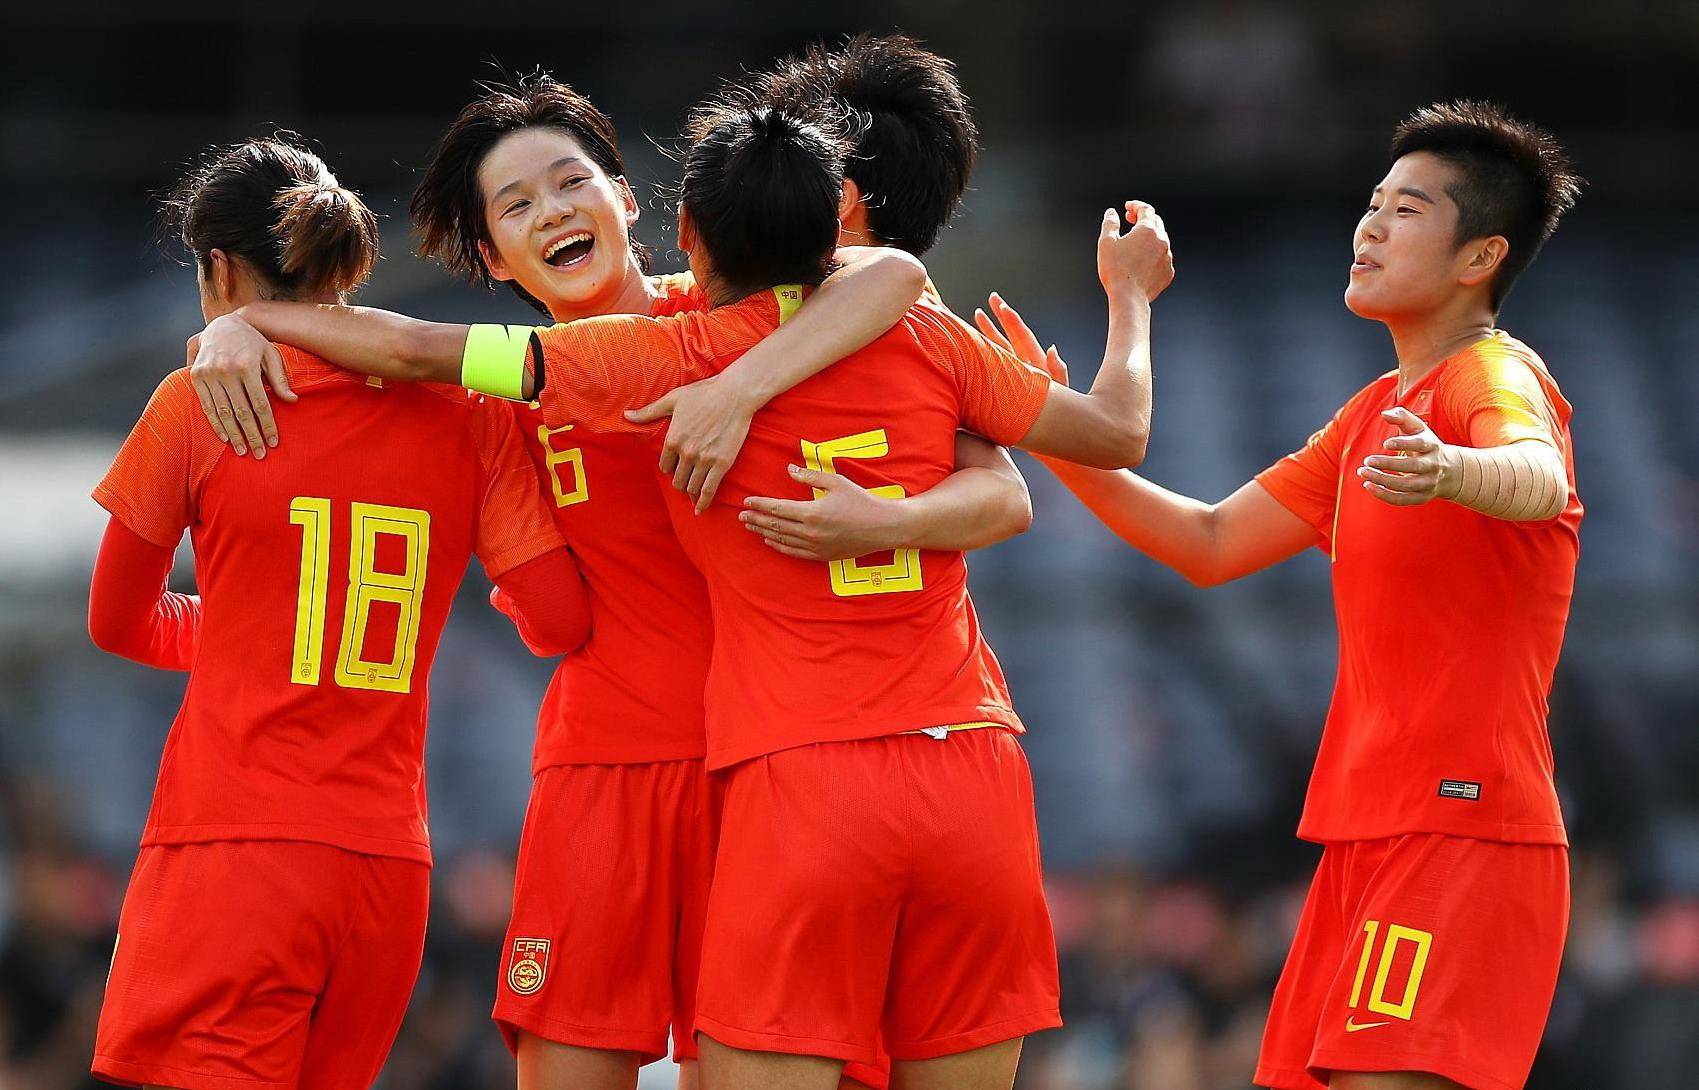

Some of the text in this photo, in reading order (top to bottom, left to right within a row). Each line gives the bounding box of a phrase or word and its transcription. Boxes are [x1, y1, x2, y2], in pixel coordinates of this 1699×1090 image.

[781, 290, 798, 300] 中国
[537, 424, 589, 509] 6
[289, 496, 431, 694] 18
[516, 941, 547, 952] CFA
[1348, 920, 1433, 1021] 10
